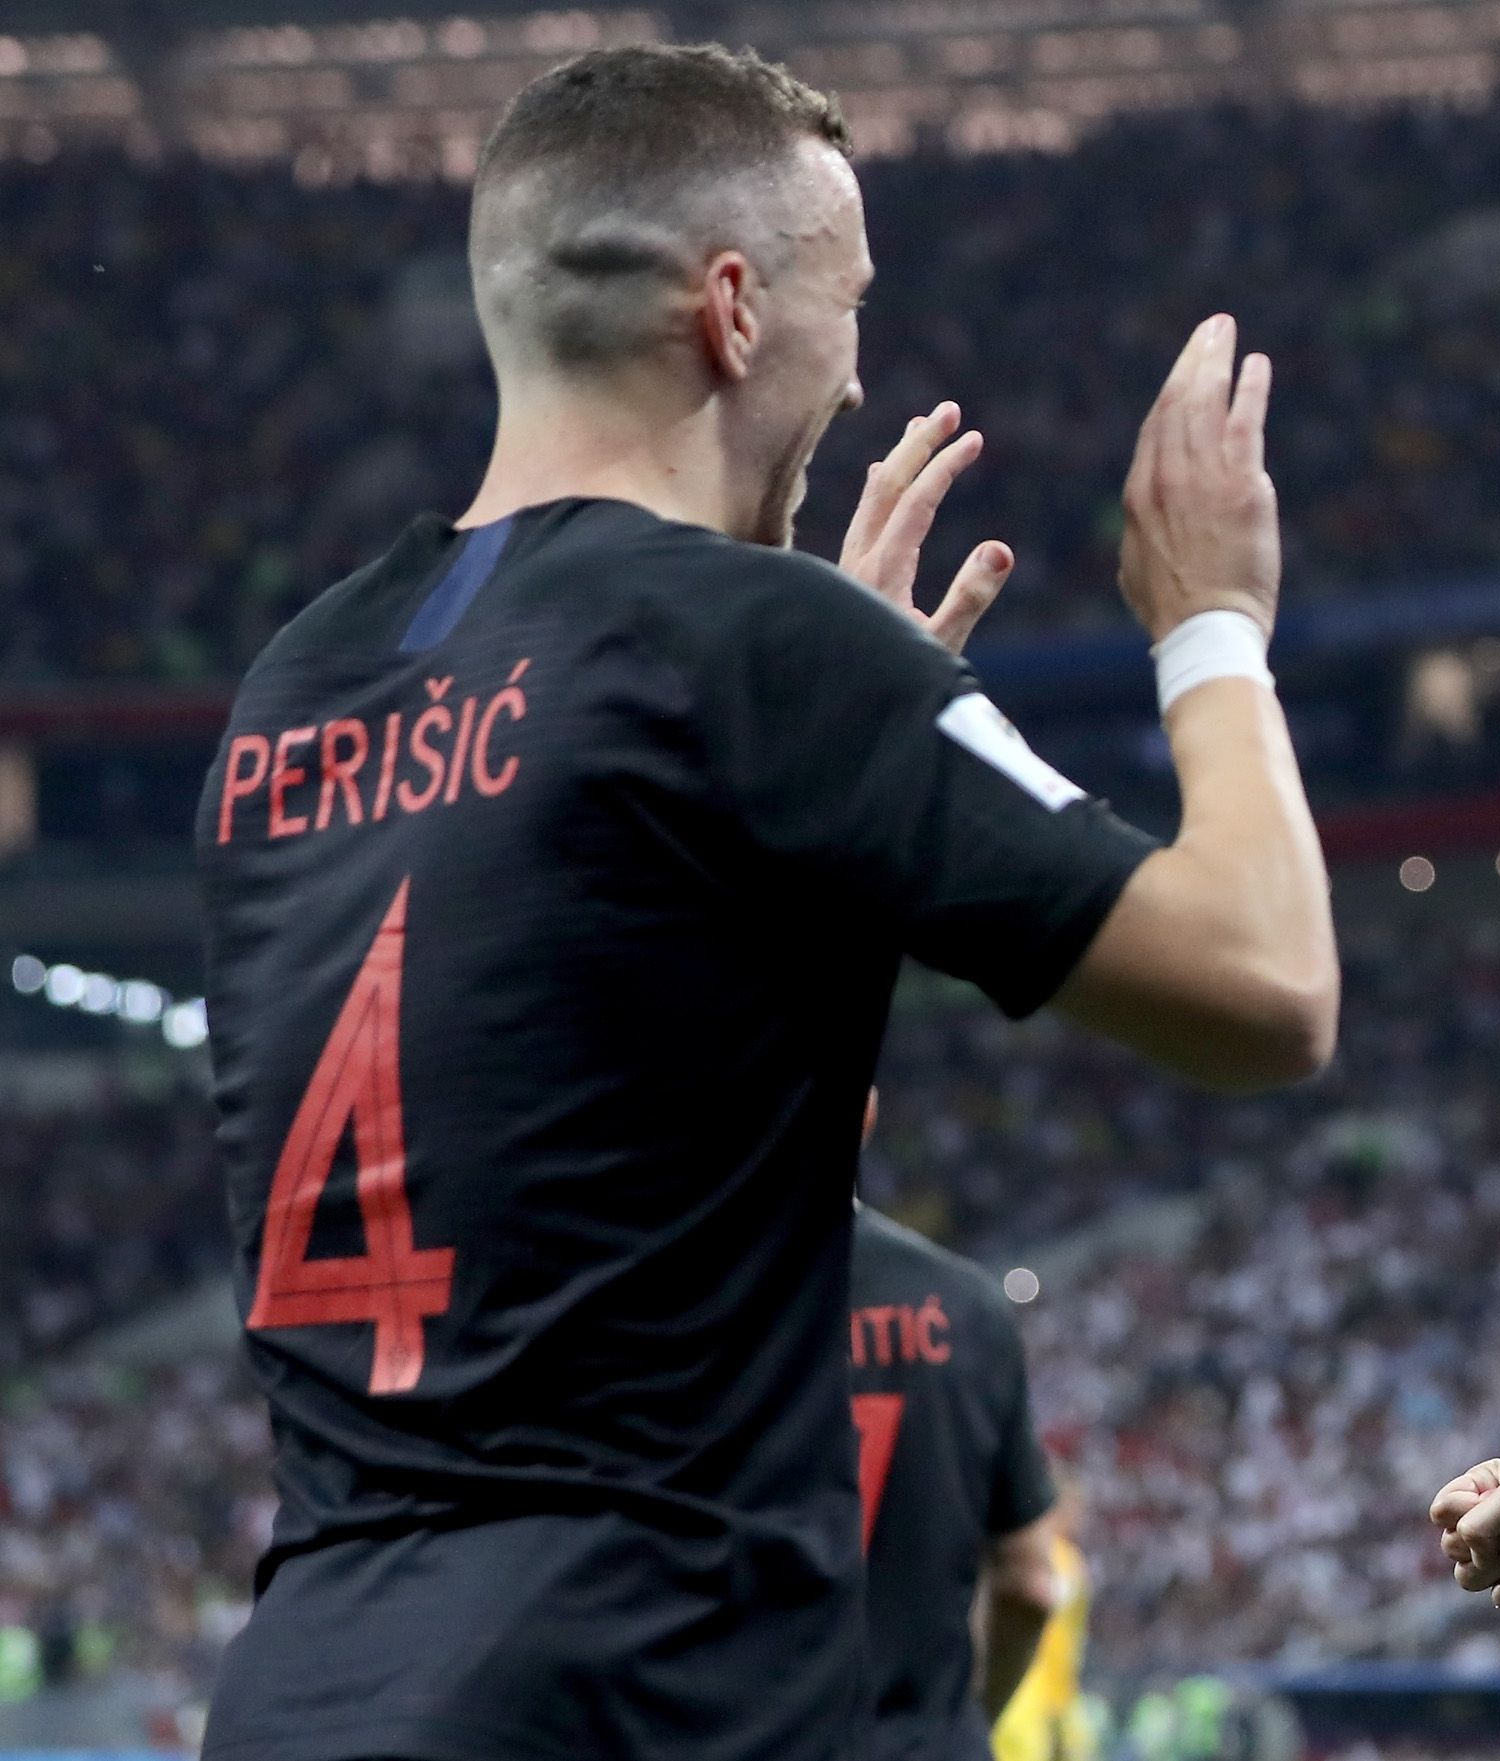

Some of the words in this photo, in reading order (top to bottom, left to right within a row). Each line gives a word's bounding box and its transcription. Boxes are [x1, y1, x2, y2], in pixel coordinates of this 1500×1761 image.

[217, 658, 531, 845] PERIŠIĆ
[246, 874, 456, 1396] 4
[851, 1294, 950, 1367] ITIĆ
